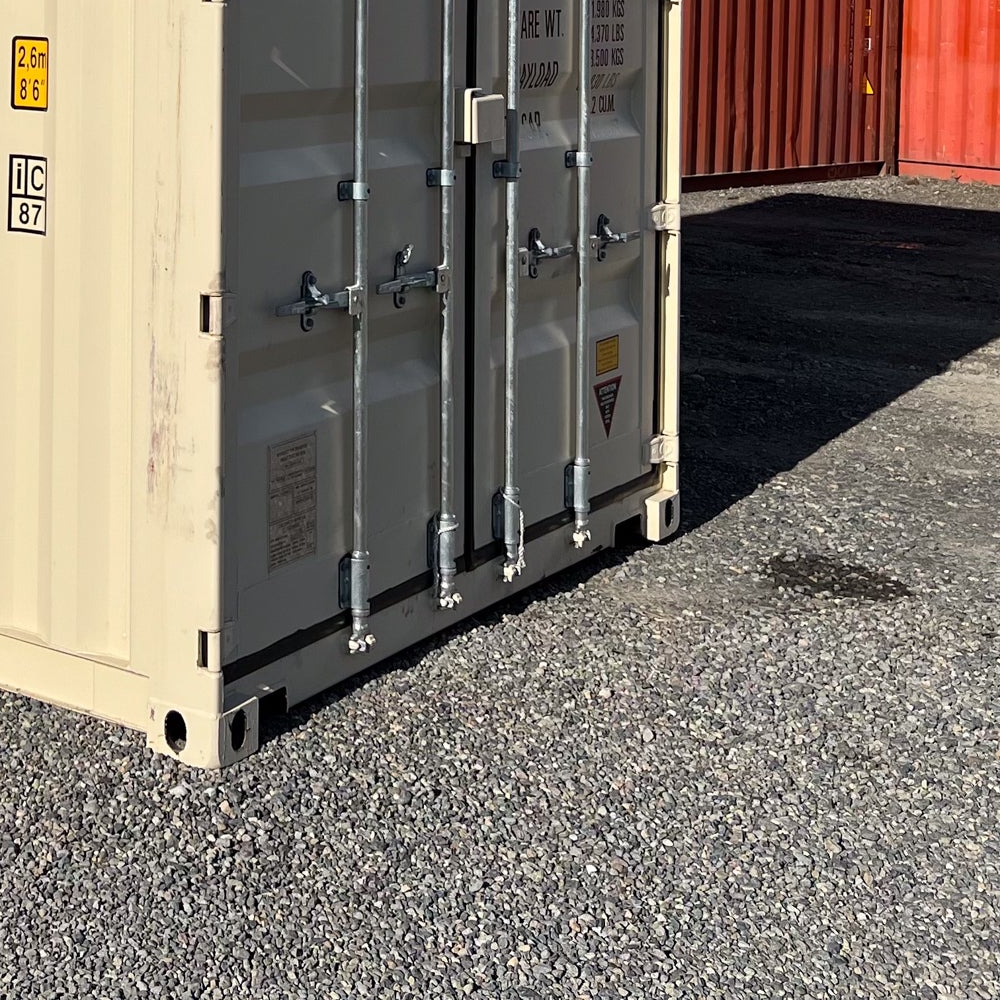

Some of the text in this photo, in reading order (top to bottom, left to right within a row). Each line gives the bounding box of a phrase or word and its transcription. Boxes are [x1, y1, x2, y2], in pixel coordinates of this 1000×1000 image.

[612, 0, 625, 18] KGS
[520, 9, 564, 39] ARE WT.
[612, 23, 624, 42] LBS
[18, 46, 46, 72] 2,6m
[611, 47, 624, 66] KGS
[520, 61, 559, 90] AYLOAD
[19, 203, 42, 226] 87
